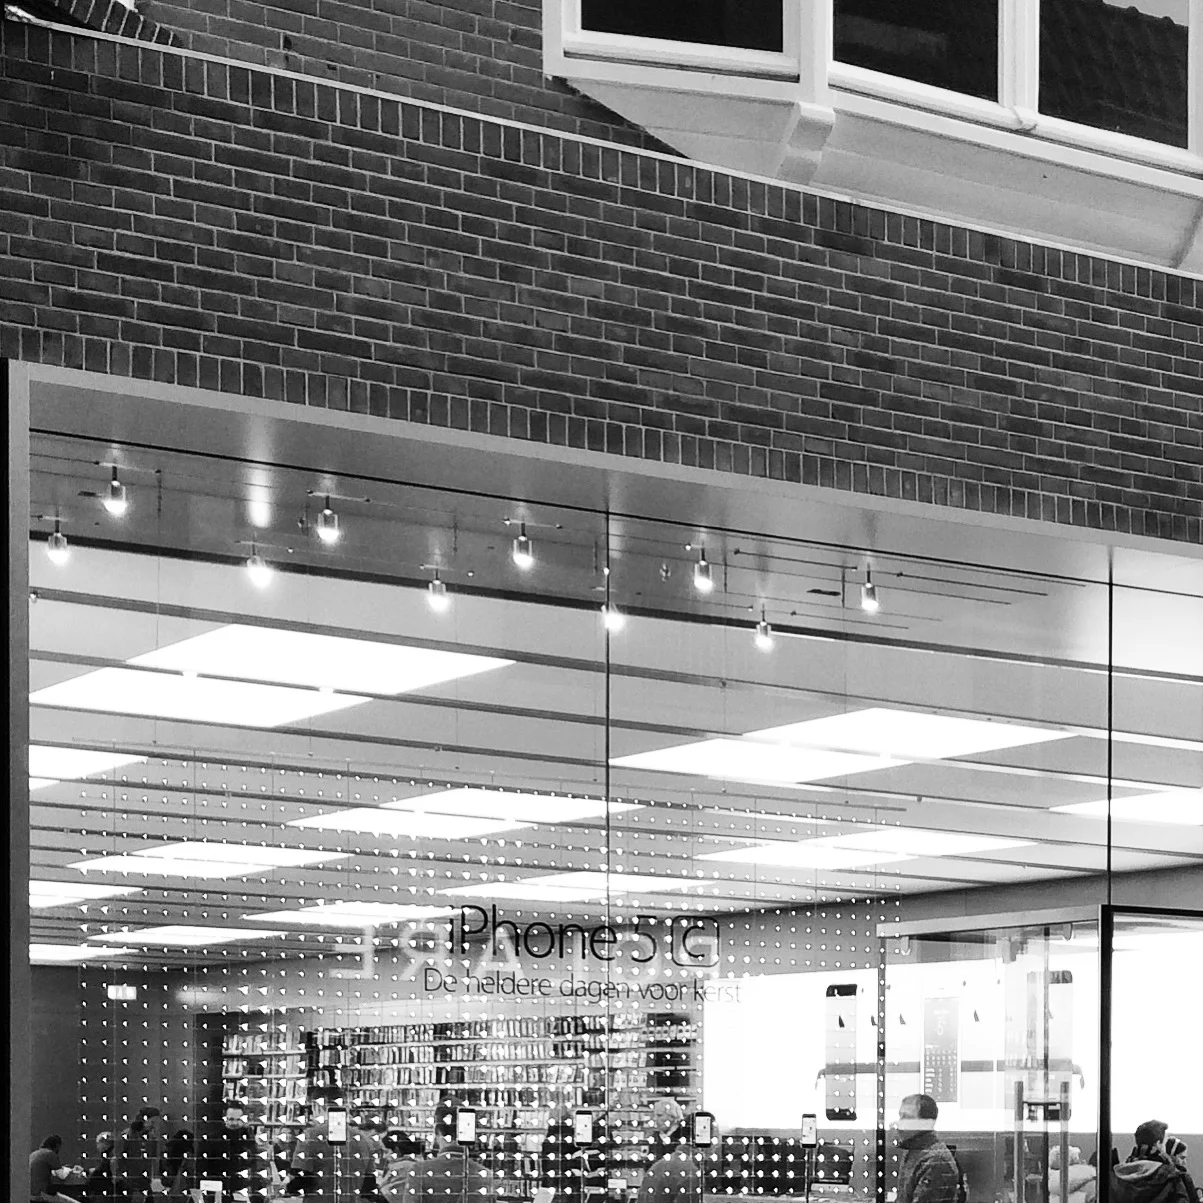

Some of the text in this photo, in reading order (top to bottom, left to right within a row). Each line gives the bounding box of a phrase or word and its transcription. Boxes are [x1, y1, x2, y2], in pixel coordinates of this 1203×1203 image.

[448, 904, 617, 962] iPhone
[424, 967, 742, 1004] De heldere dagen voor kerst
